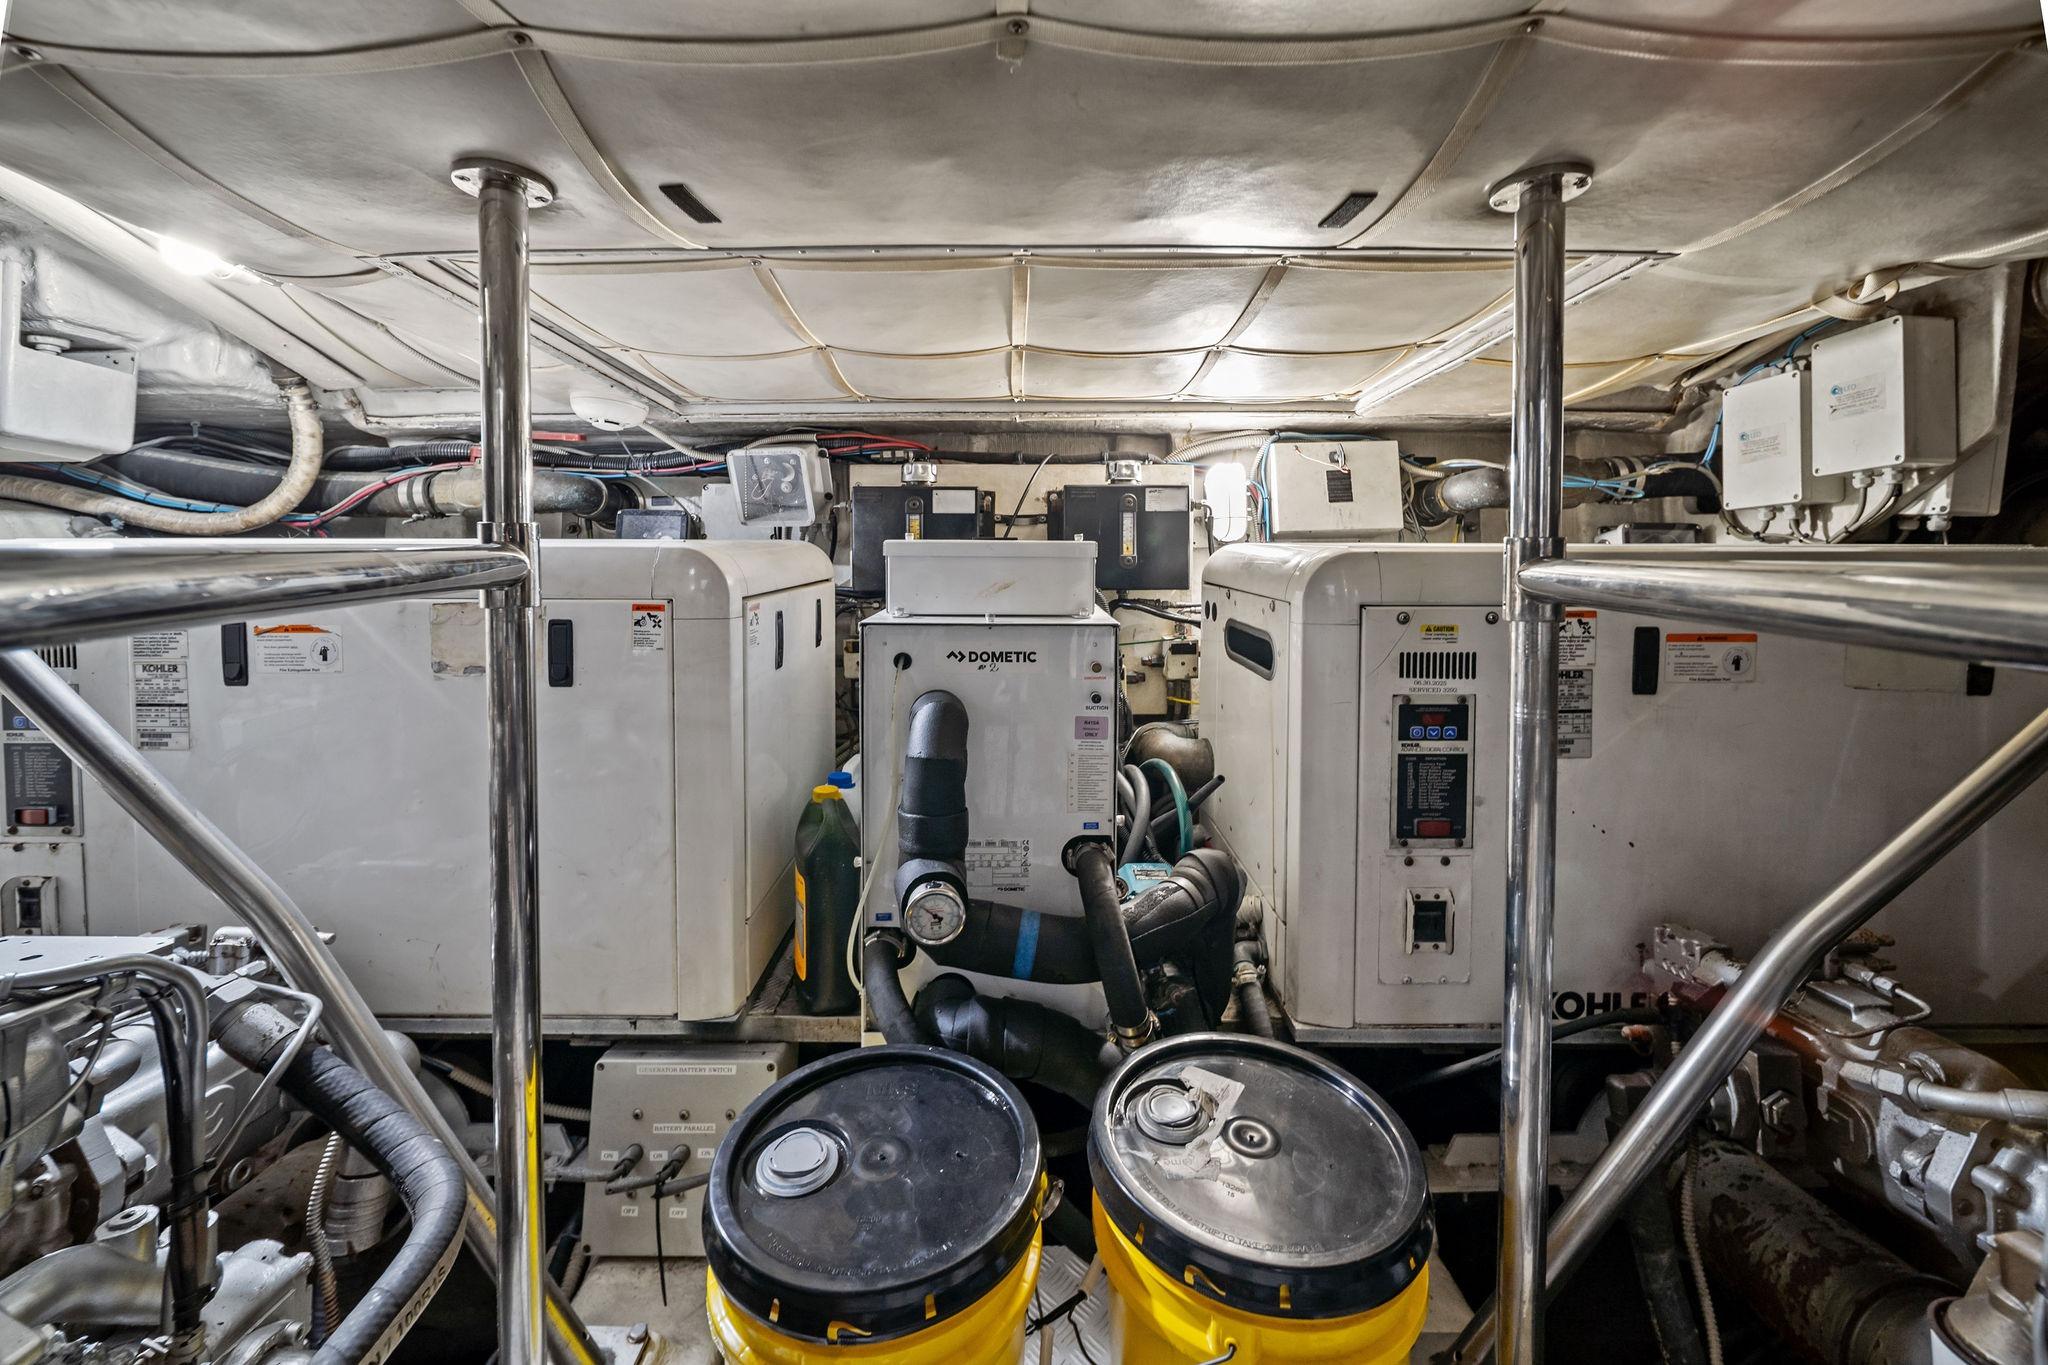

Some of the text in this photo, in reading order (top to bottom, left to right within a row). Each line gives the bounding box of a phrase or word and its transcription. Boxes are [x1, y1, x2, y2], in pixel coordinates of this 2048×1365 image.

[1433, 625, 1455, 633] CAUTION
[968, 651, 1037, 663] DOMETIC
[142, 664, 179, 673] KOHLER
[1222, 1232, 1236, 1243] TO
